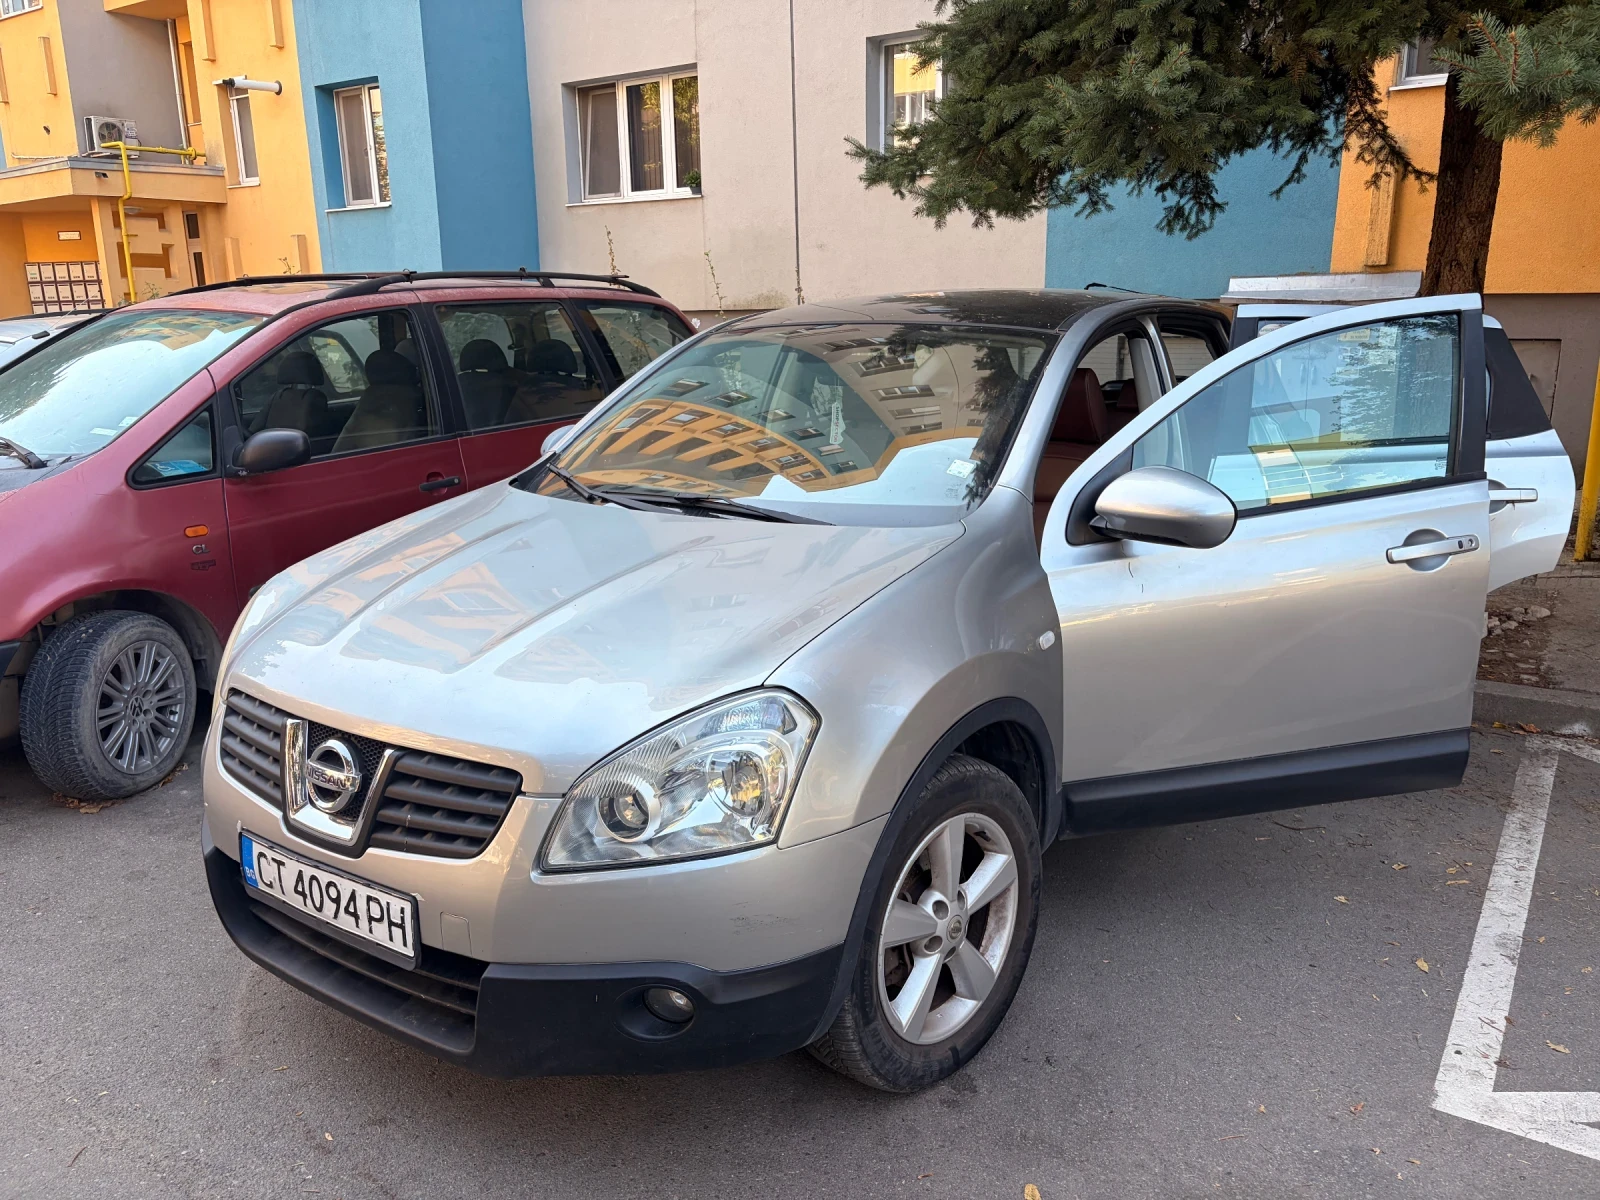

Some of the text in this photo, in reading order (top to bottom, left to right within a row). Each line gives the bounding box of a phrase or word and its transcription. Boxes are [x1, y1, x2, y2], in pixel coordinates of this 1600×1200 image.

[192, 544, 210, 554] CL
[306, 764, 347, 789] NISSAN
[244, 866, 256, 879] BG
[257, 851, 408, 948] CT 4094 PH
